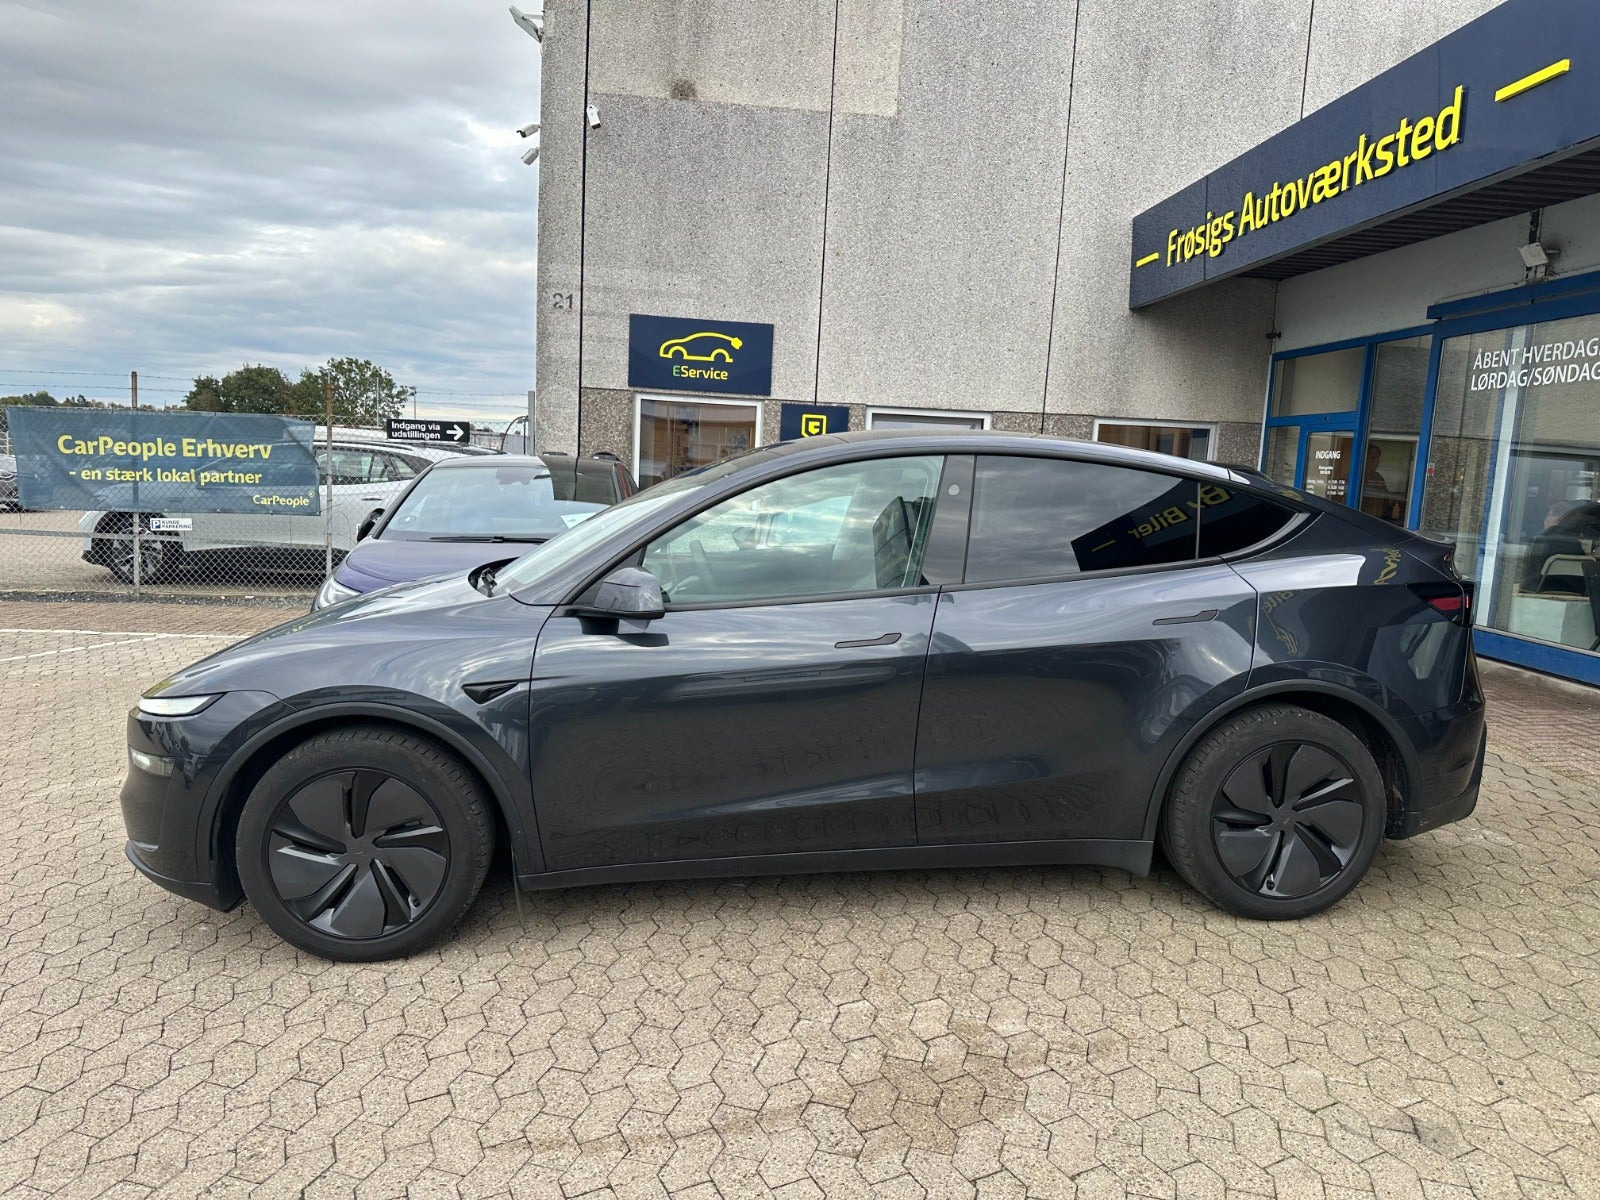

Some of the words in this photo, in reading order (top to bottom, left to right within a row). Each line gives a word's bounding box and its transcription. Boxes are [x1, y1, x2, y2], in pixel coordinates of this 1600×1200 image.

[1166, 210, 1235, 266] Frøsigs
[1237, 84, 1464, 236] Autoværksted
[1473, 348, 1519, 370] ÅBENT
[1521, 337, 1600, 364] HVERDAG
[672, 365, 728, 380] EService
[391, 421, 426, 431] Indgang
[428, 423, 440, 431] via
[391, 430, 440, 440] udstillingen
[57, 434, 177, 460] CarPeople
[181, 437, 272, 460] Erhverv
[1315, 450, 1341, 459] INDGANG
[81, 470, 102, 481] en
[106, 469, 153, 482] stærk
[157, 468, 196, 482] lokal
[200, 470, 262, 486] partner
[252, 494, 310, 508] CarPeople
